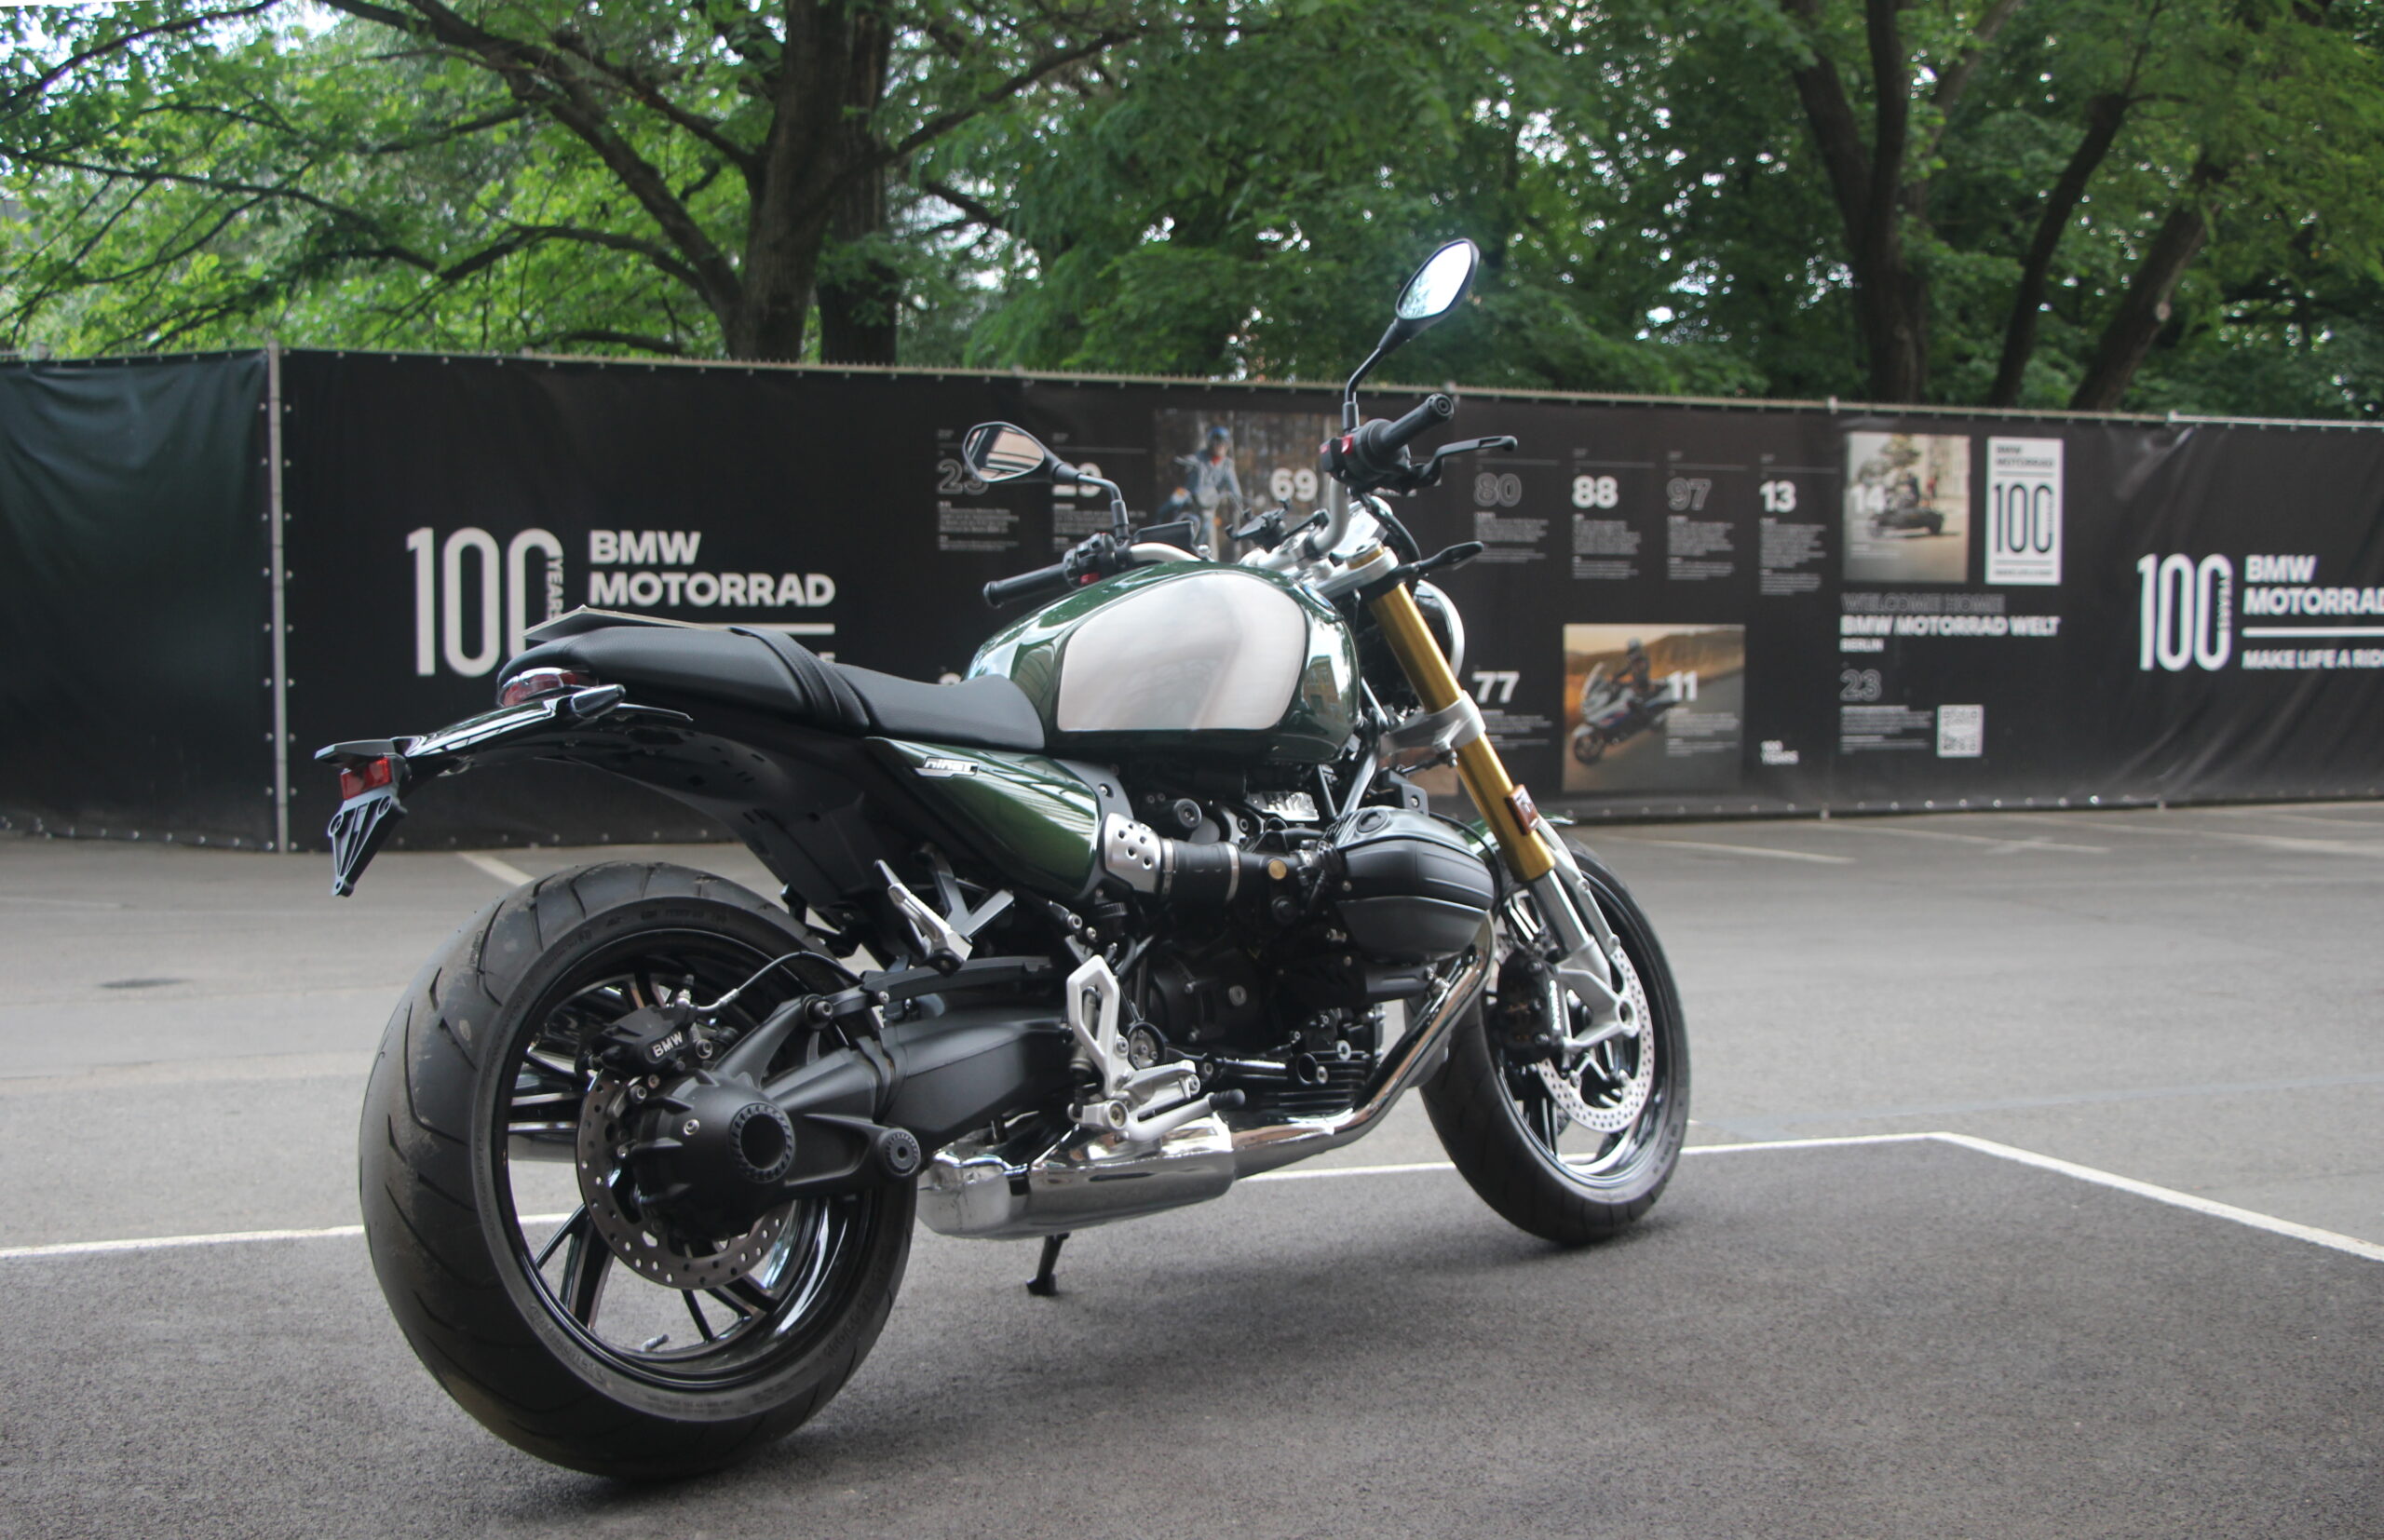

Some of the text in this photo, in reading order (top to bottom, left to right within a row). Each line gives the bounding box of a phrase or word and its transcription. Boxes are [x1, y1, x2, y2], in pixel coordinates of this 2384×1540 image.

[1270, 467, 1318, 502] 69
[1474, 472, 1522, 507] 80
[1572, 475, 1619, 509] 88
[1666, 477, 1712, 511] 97
[1759, 480, 1796, 513] 13
[1849, 483, 1886, 514] 14
[1994, 482, 2053, 553] 100
[589, 530, 701, 564] BMW
[2244, 554, 2317, 583] BMW
[406, 526, 563, 677] 100
[589, 572, 836, 607] MOTORRAD
[1840, 593, 2006, 614] WELCOME HOME
[2242, 588, 2384, 615] MOTORRA
[1840, 615, 2061, 636] BMW MOTORRAD WELT
[2136, 553, 2233, 671] 100
[1840, 638, 1884, 653] BERLIN
[2242, 649, 2384, 669] MAKE LIFE A RID
[1471, 670, 1520, 704] 77
[1668, 670, 1699, 703] 11
[1839, 669, 1882, 701] 23
[652, 1031, 683, 1058] BMW
